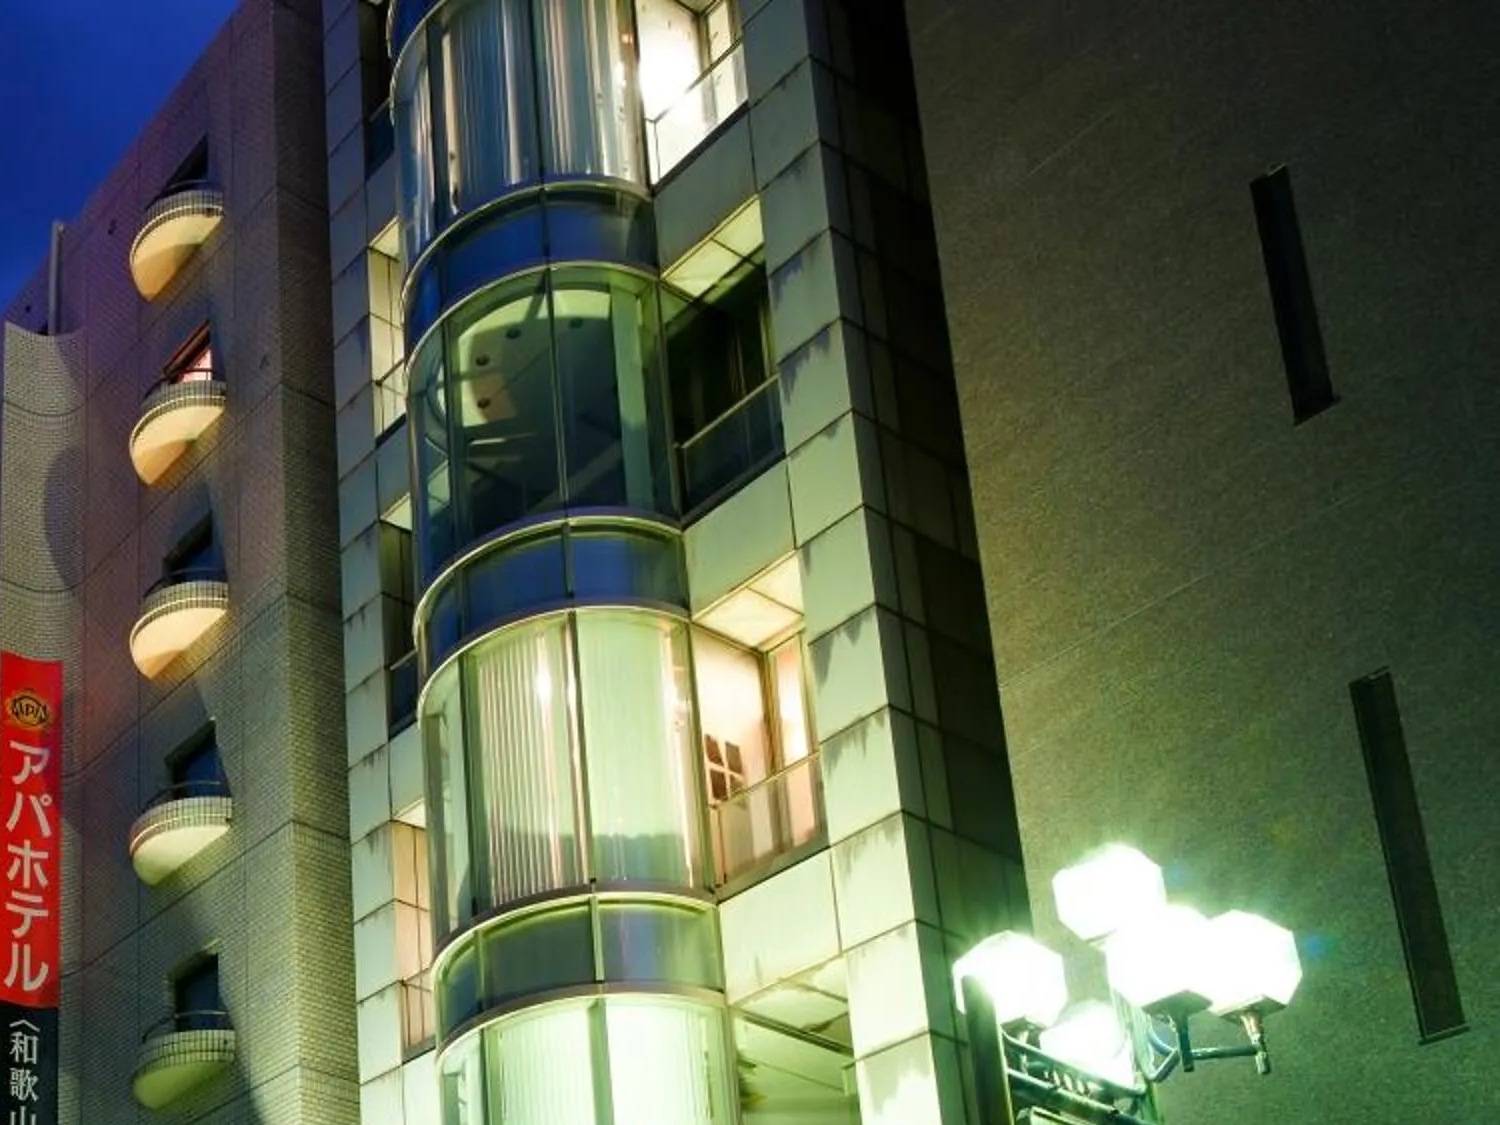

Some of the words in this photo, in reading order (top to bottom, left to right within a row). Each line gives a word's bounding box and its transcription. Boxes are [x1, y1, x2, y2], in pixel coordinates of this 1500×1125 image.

[3, 739, 53, 993] アパホテル
